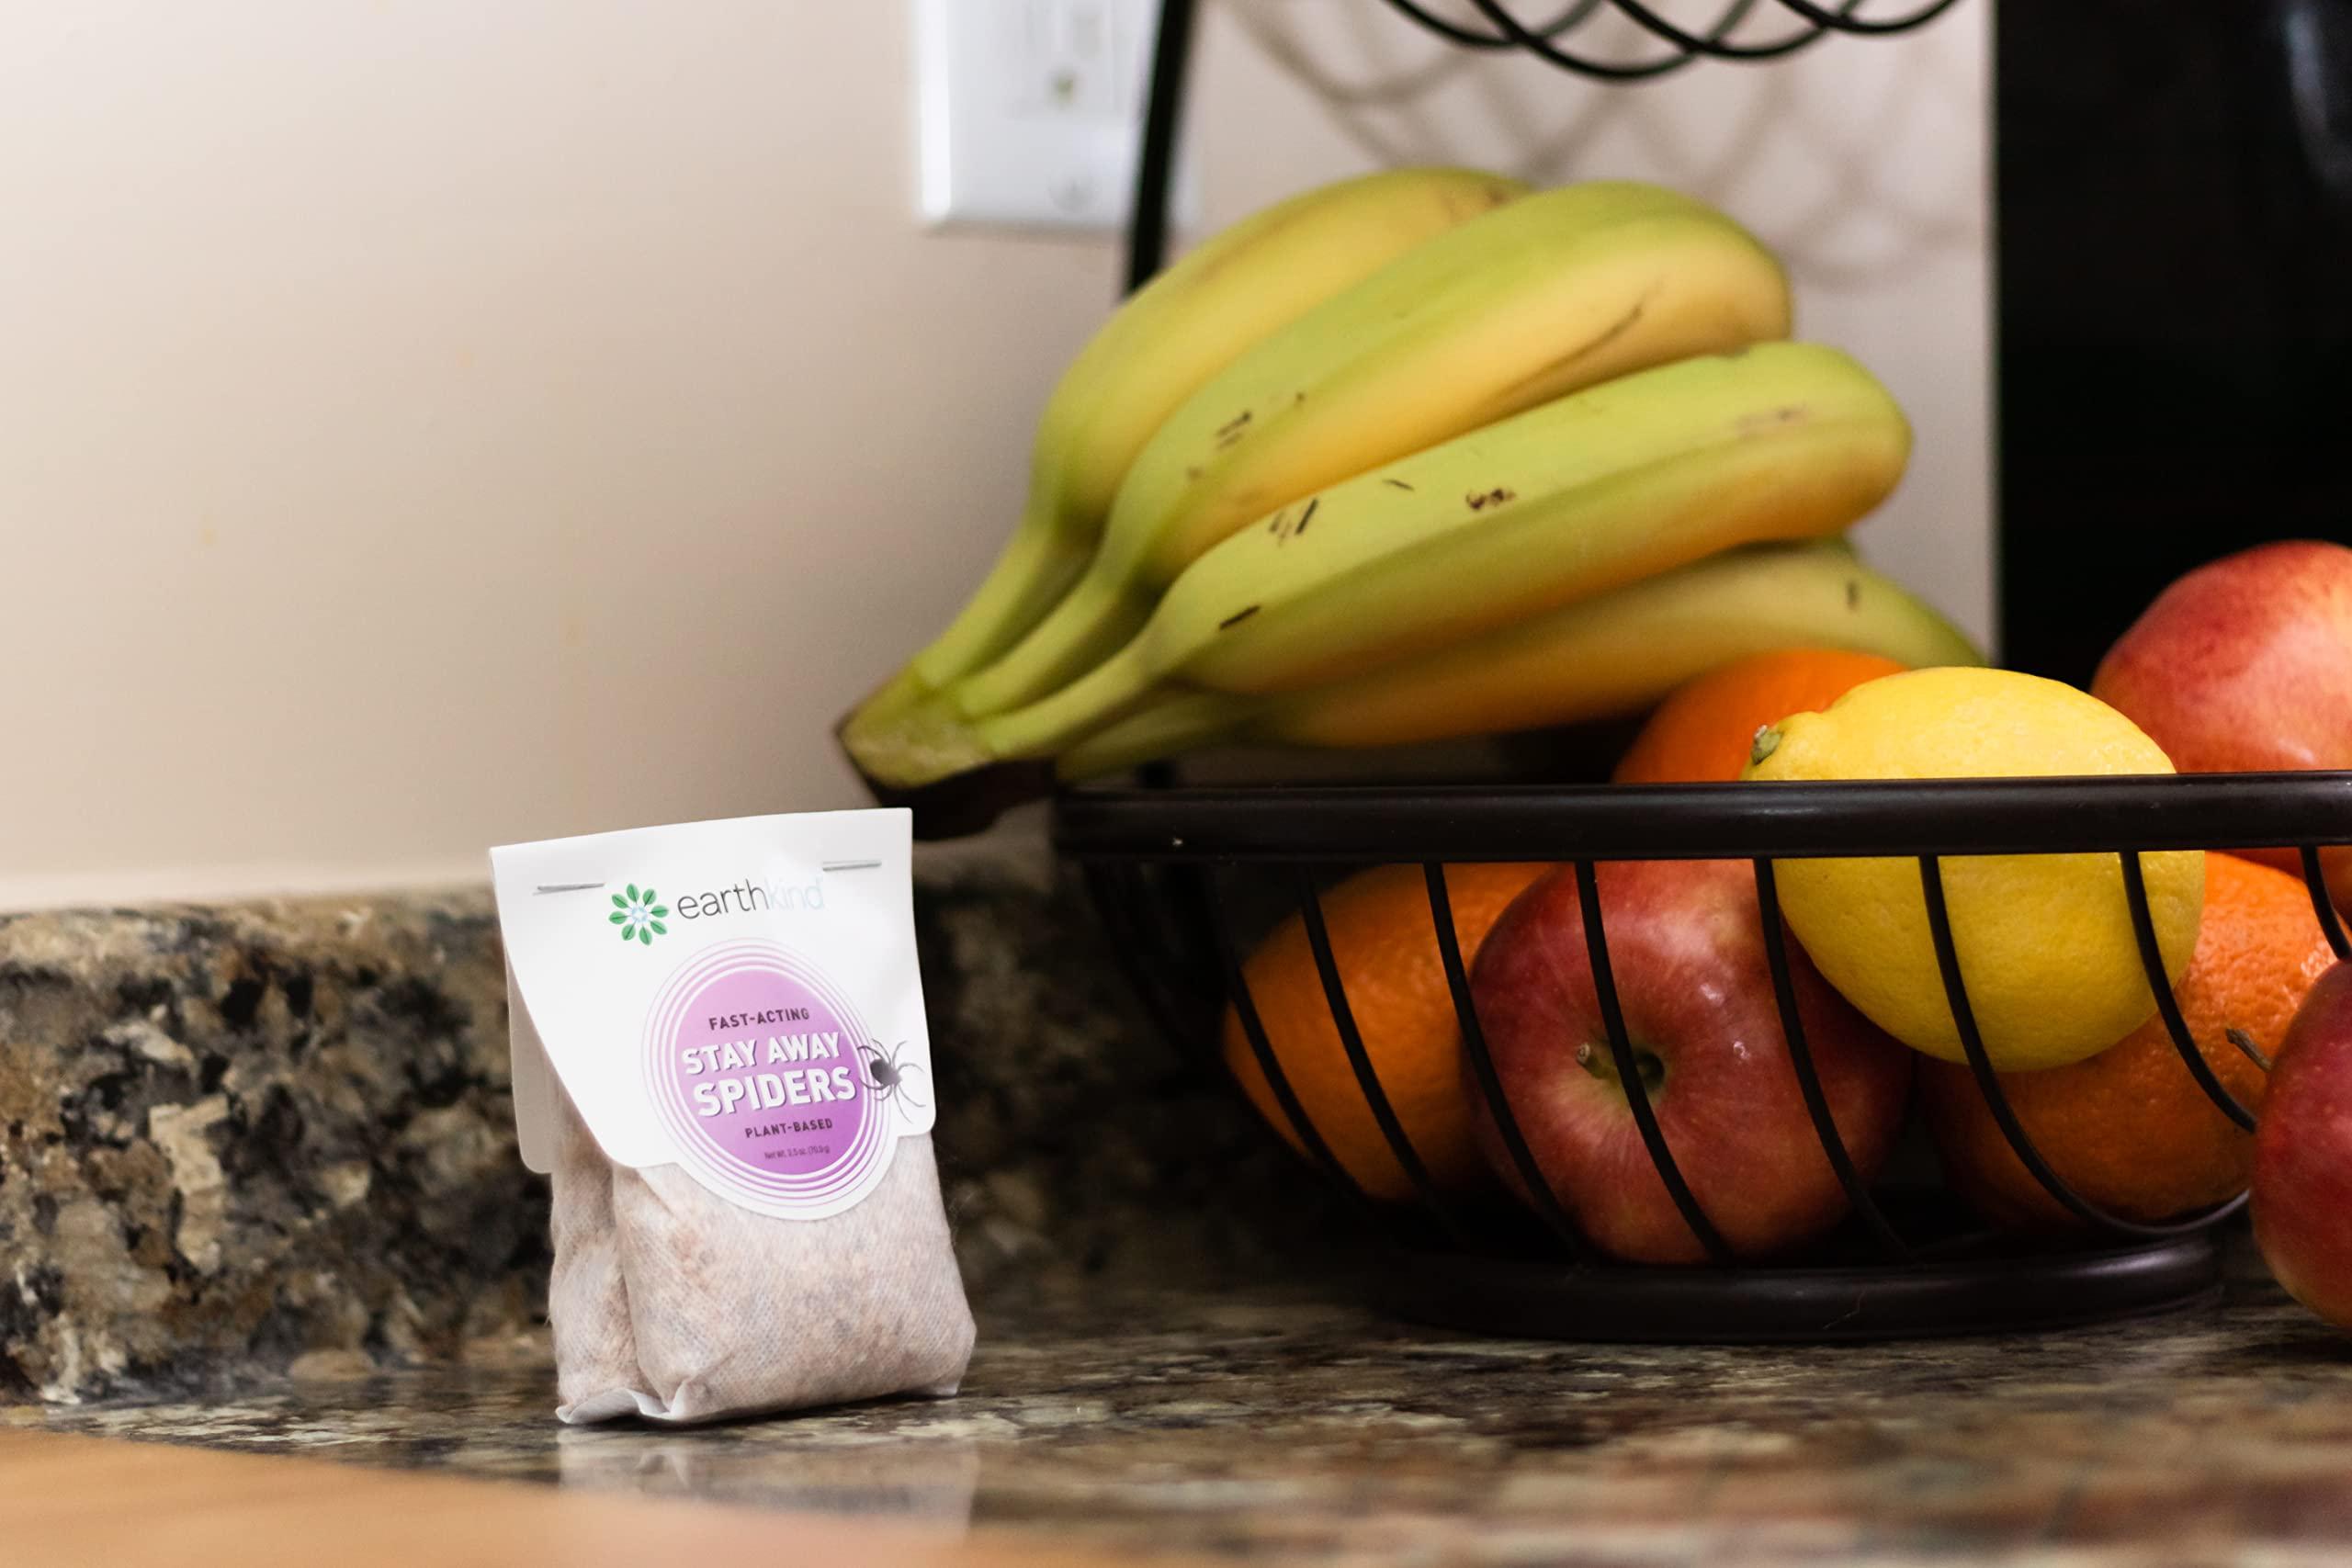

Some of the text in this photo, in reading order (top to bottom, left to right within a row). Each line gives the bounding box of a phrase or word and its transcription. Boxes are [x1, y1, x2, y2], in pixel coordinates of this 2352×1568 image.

[708, 1008, 809, 1031] FAST-ACTING
[682, 1032, 842, 1076] STAY AWAY
[694, 1066, 857, 1118] SPIDERS
[745, 1118, 833, 1138] PLANT-BASED
